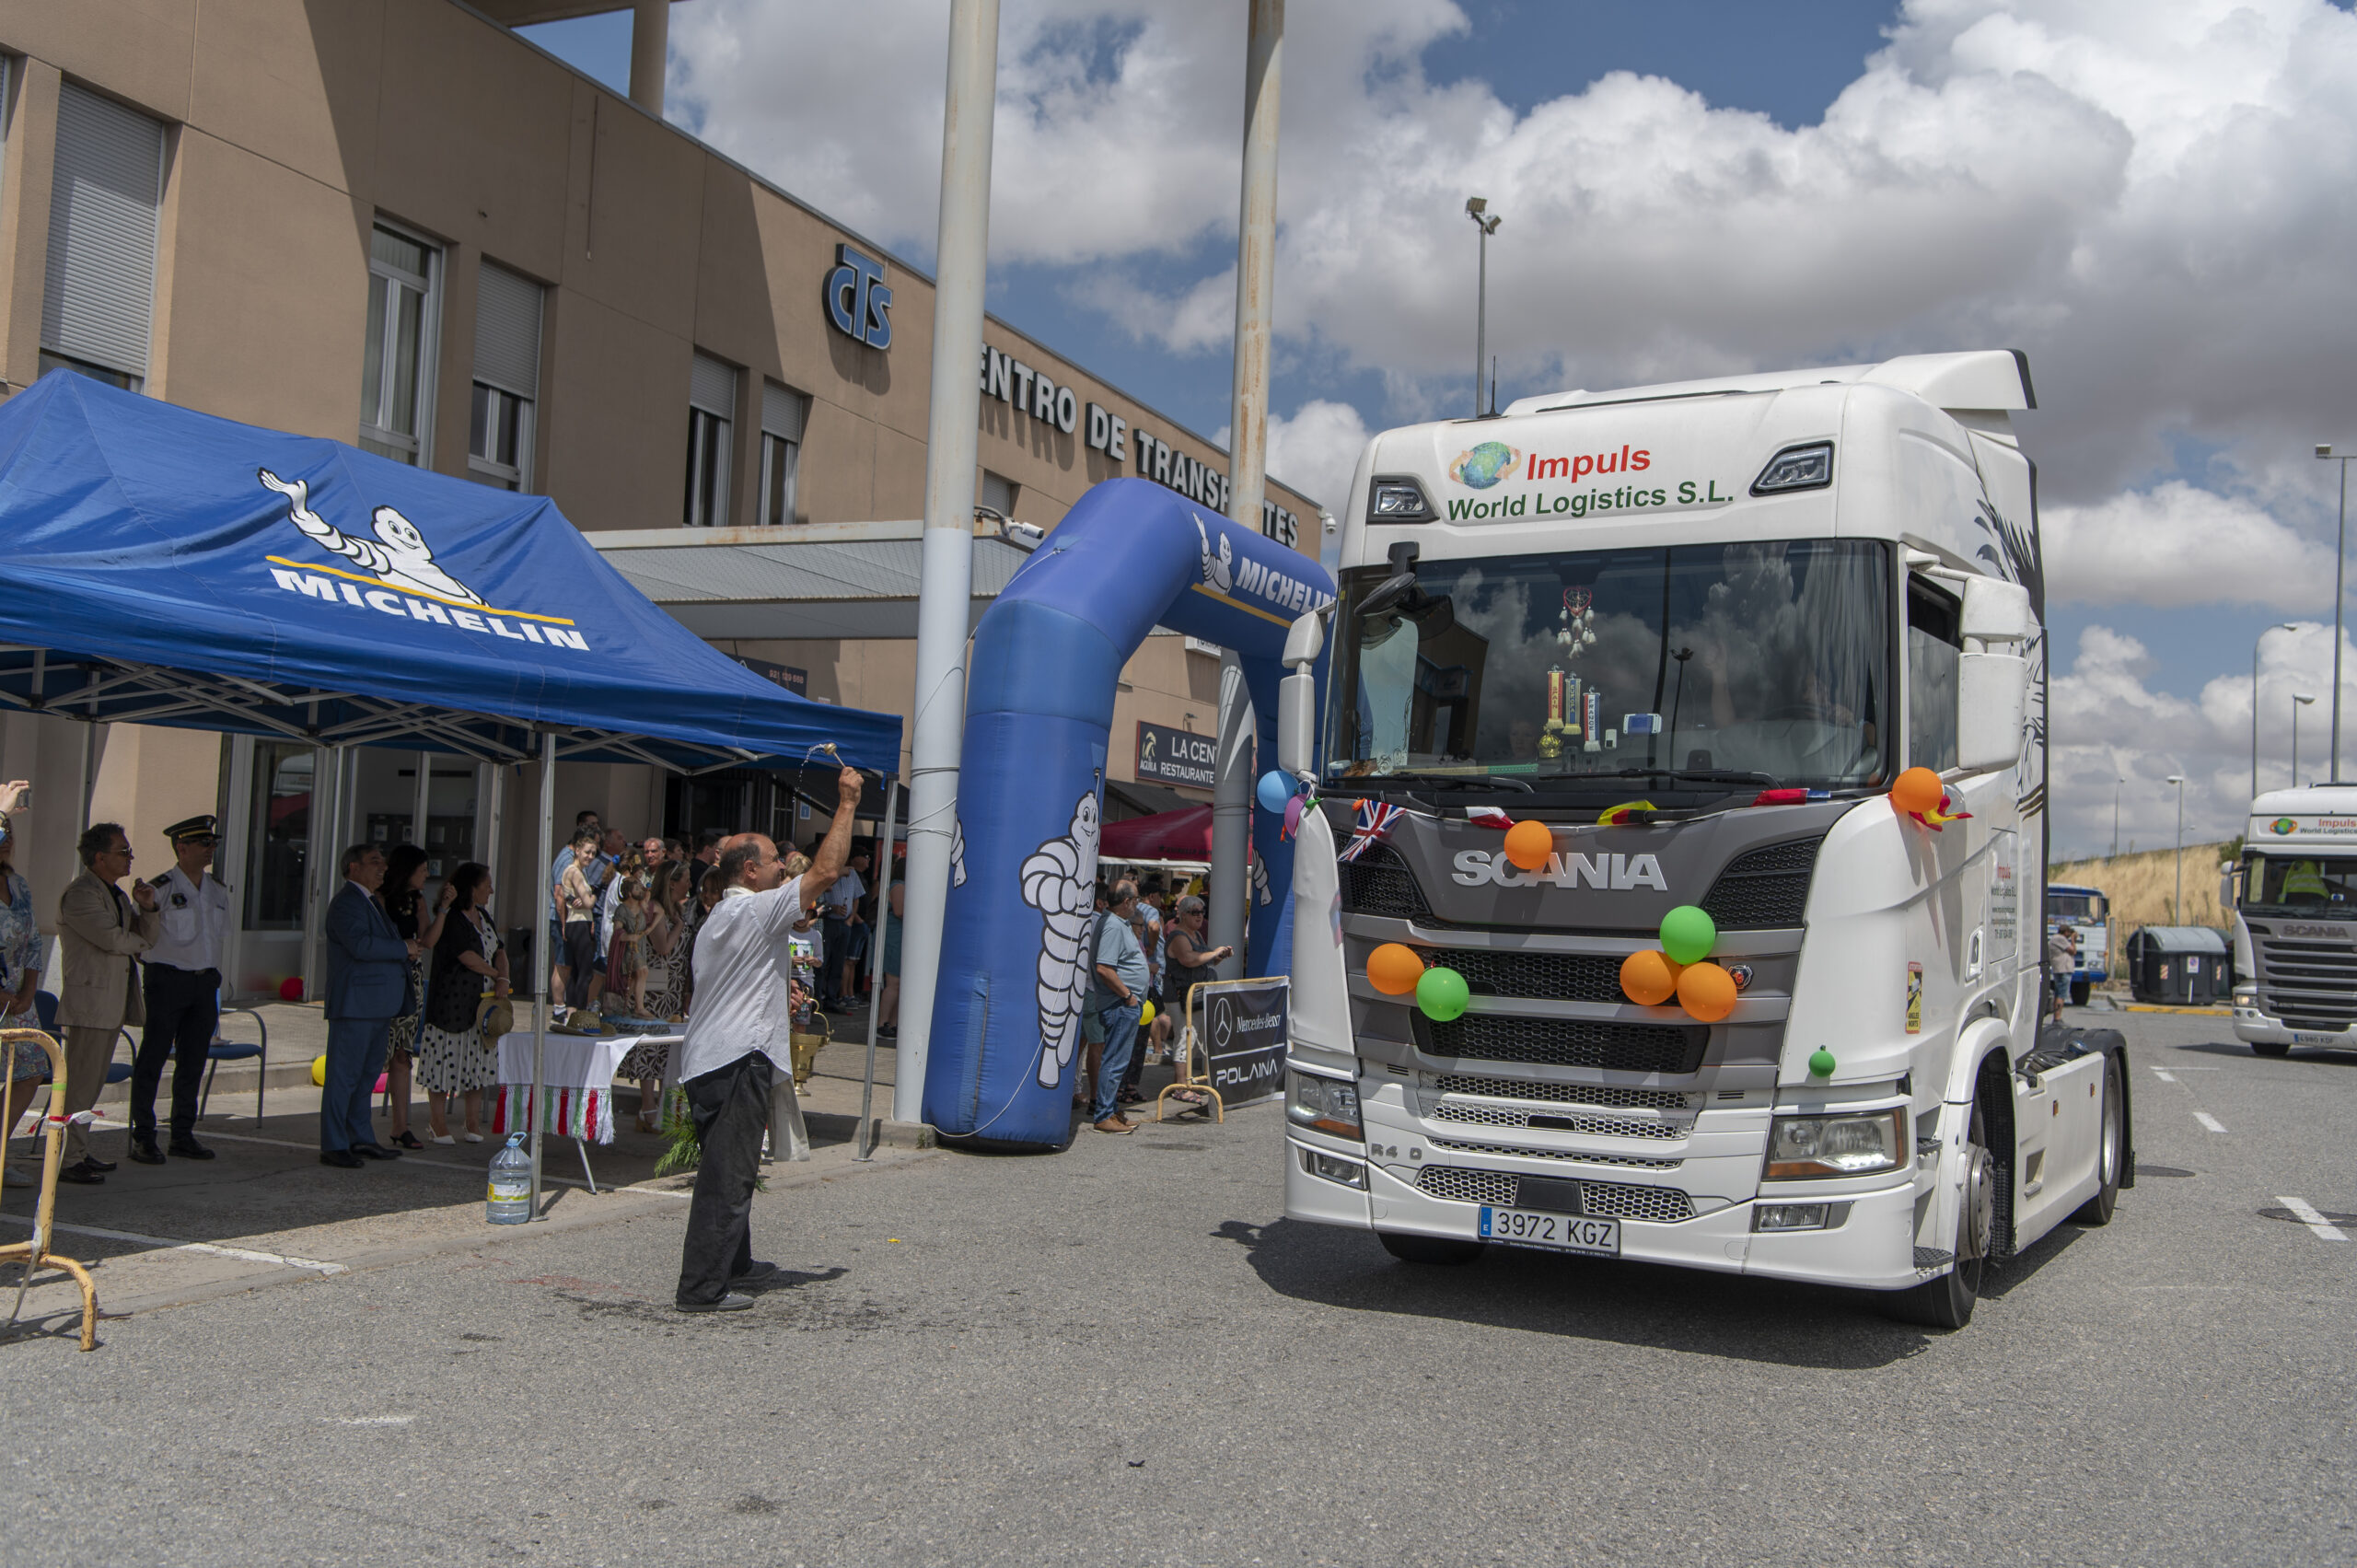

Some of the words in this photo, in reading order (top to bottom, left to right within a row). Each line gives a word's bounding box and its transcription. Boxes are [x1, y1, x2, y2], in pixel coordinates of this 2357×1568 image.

[822, 243, 892, 350] CTS
[1085, 402, 1126, 461] DE
[1527, 445, 1651, 482] Impuls
[1448, 494, 1526, 520] World
[1536, 486, 1666, 517] Logistics
[1678, 480, 1734, 504] S.L.
[270, 568, 590, 651] MICHELIN
[1171, 737, 1188, 759] LA
[1190, 741, 1216, 764] CEN
[1160, 761, 1214, 784] RESTAURANTE
[2318, 818, 2357, 829] Impuls
[1452, 850, 1667, 891] SCANIA
[2283, 924, 2349, 937] SCANIA
[1237, 1013, 1281, 1033] Mercedes-Benz
[1217, 1058, 1278, 1086] POLAINA
[1498, 1212, 1556, 1241] 3972
[1568, 1219, 1612, 1248] KGZ
